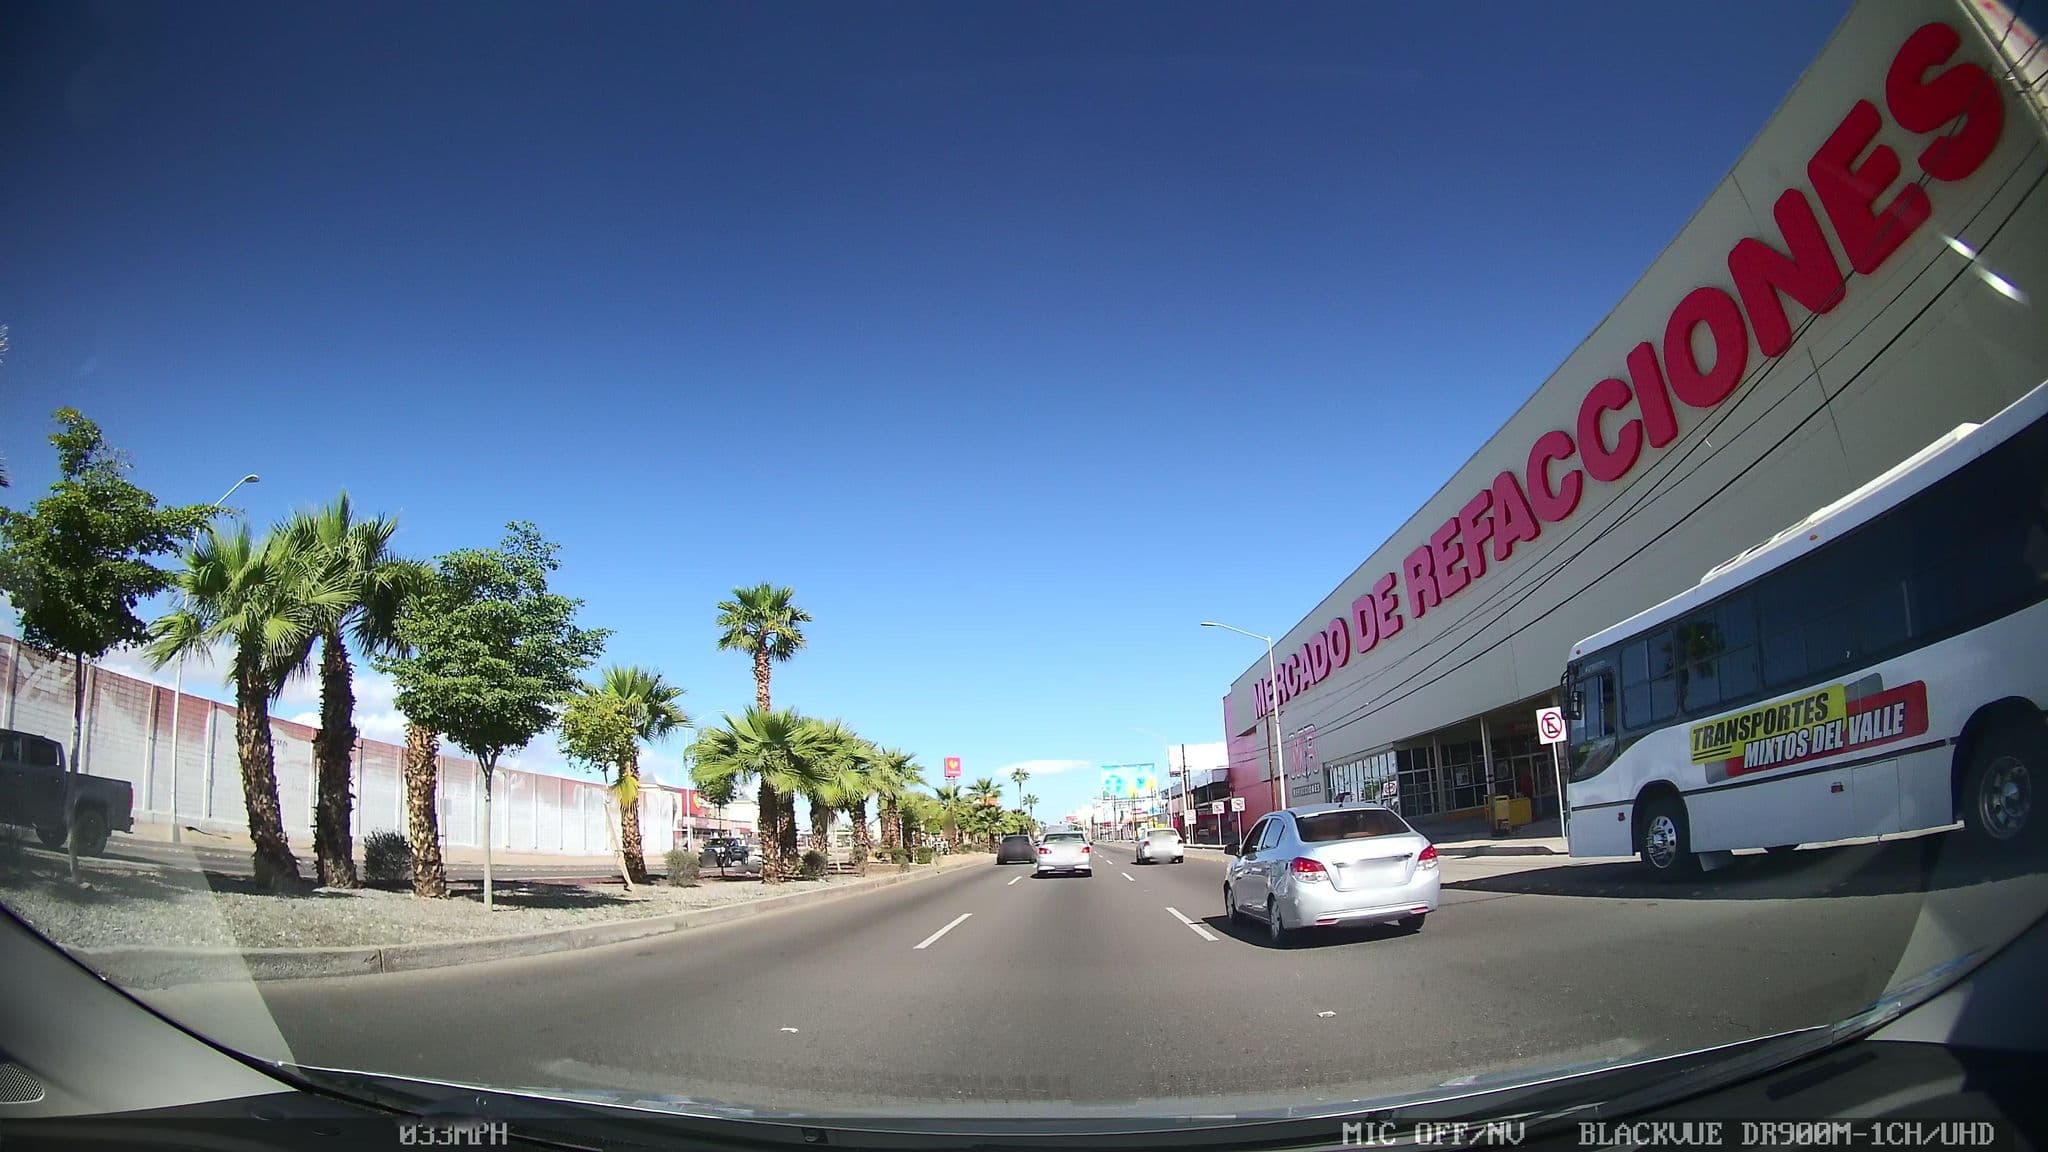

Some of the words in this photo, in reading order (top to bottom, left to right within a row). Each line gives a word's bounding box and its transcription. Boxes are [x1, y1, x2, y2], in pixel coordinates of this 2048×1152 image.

[1253, 617, 1350, 720] MERCADO
[1352, 572, 1403, 653] DE
[1404, 22, 2004, 618] REFACCIONES
[1692, 692, 1829, 752] TRANSPORTES
[1743, 727, 1810, 769] MIXTOS
[1811, 718, 1844, 754] DEL
[1849, 702, 1905, 746] VALLE
